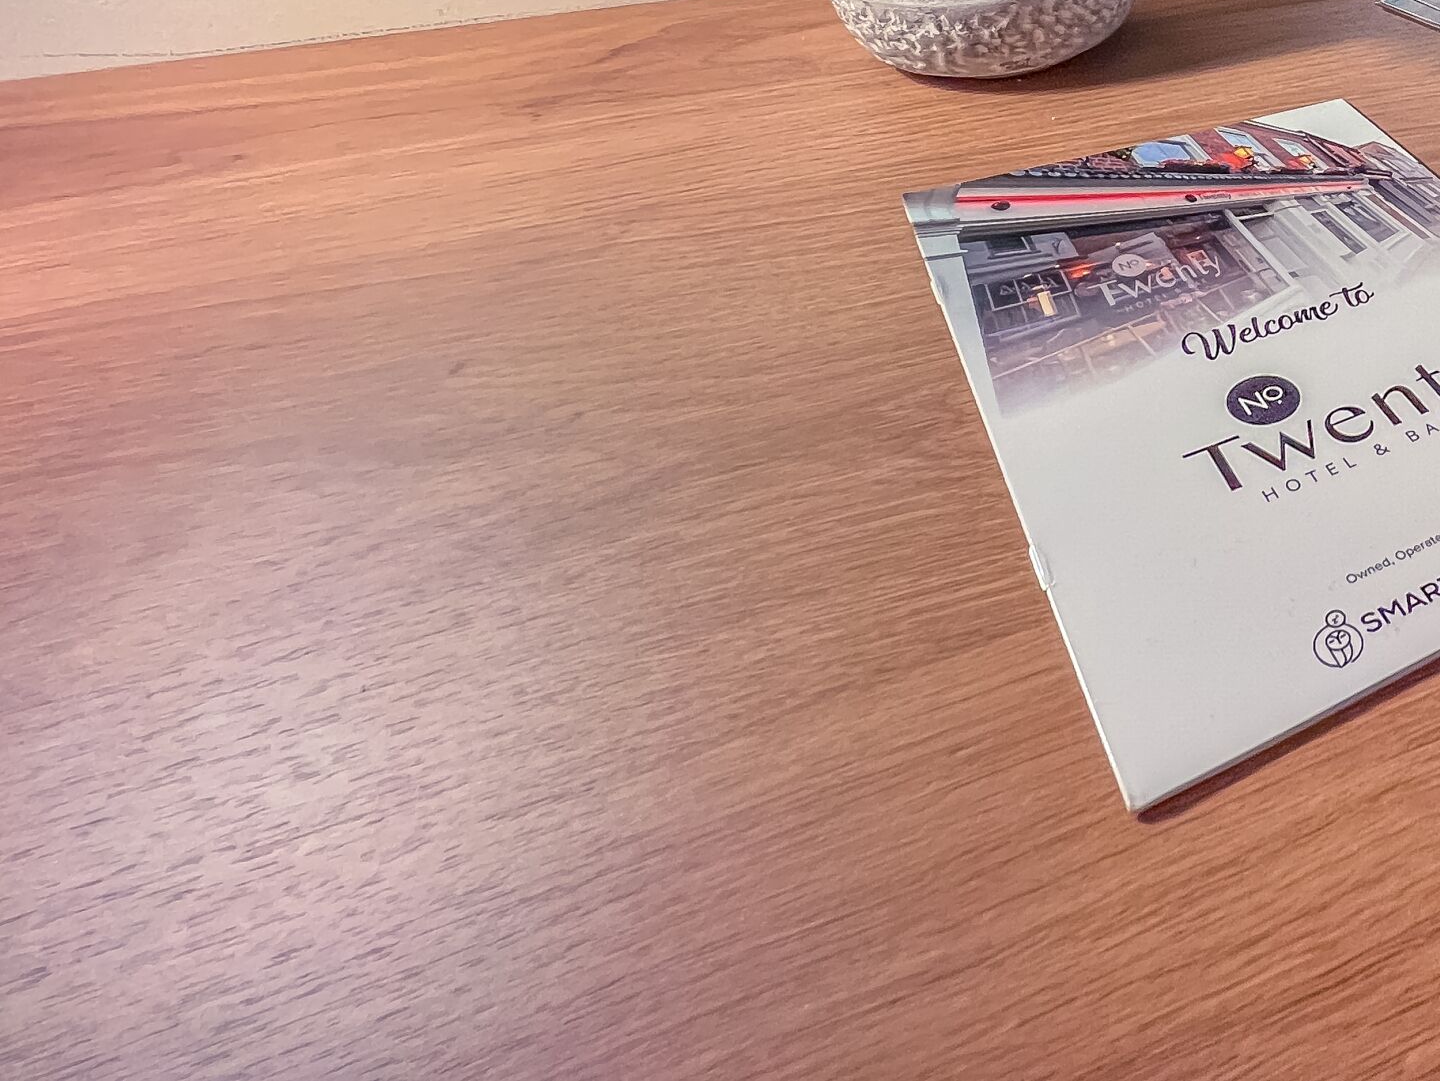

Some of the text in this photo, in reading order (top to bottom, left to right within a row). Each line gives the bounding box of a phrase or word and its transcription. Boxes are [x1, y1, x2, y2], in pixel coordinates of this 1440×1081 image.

[1087, 255, 1223, 306] Twenty
[1181, 282, 1375, 361] Welcome to
[1261, 456, 1358, 502] HOTEL
[1373, 442, 1391, 456] &
[1346, 556, 1396, 584] Owned,
